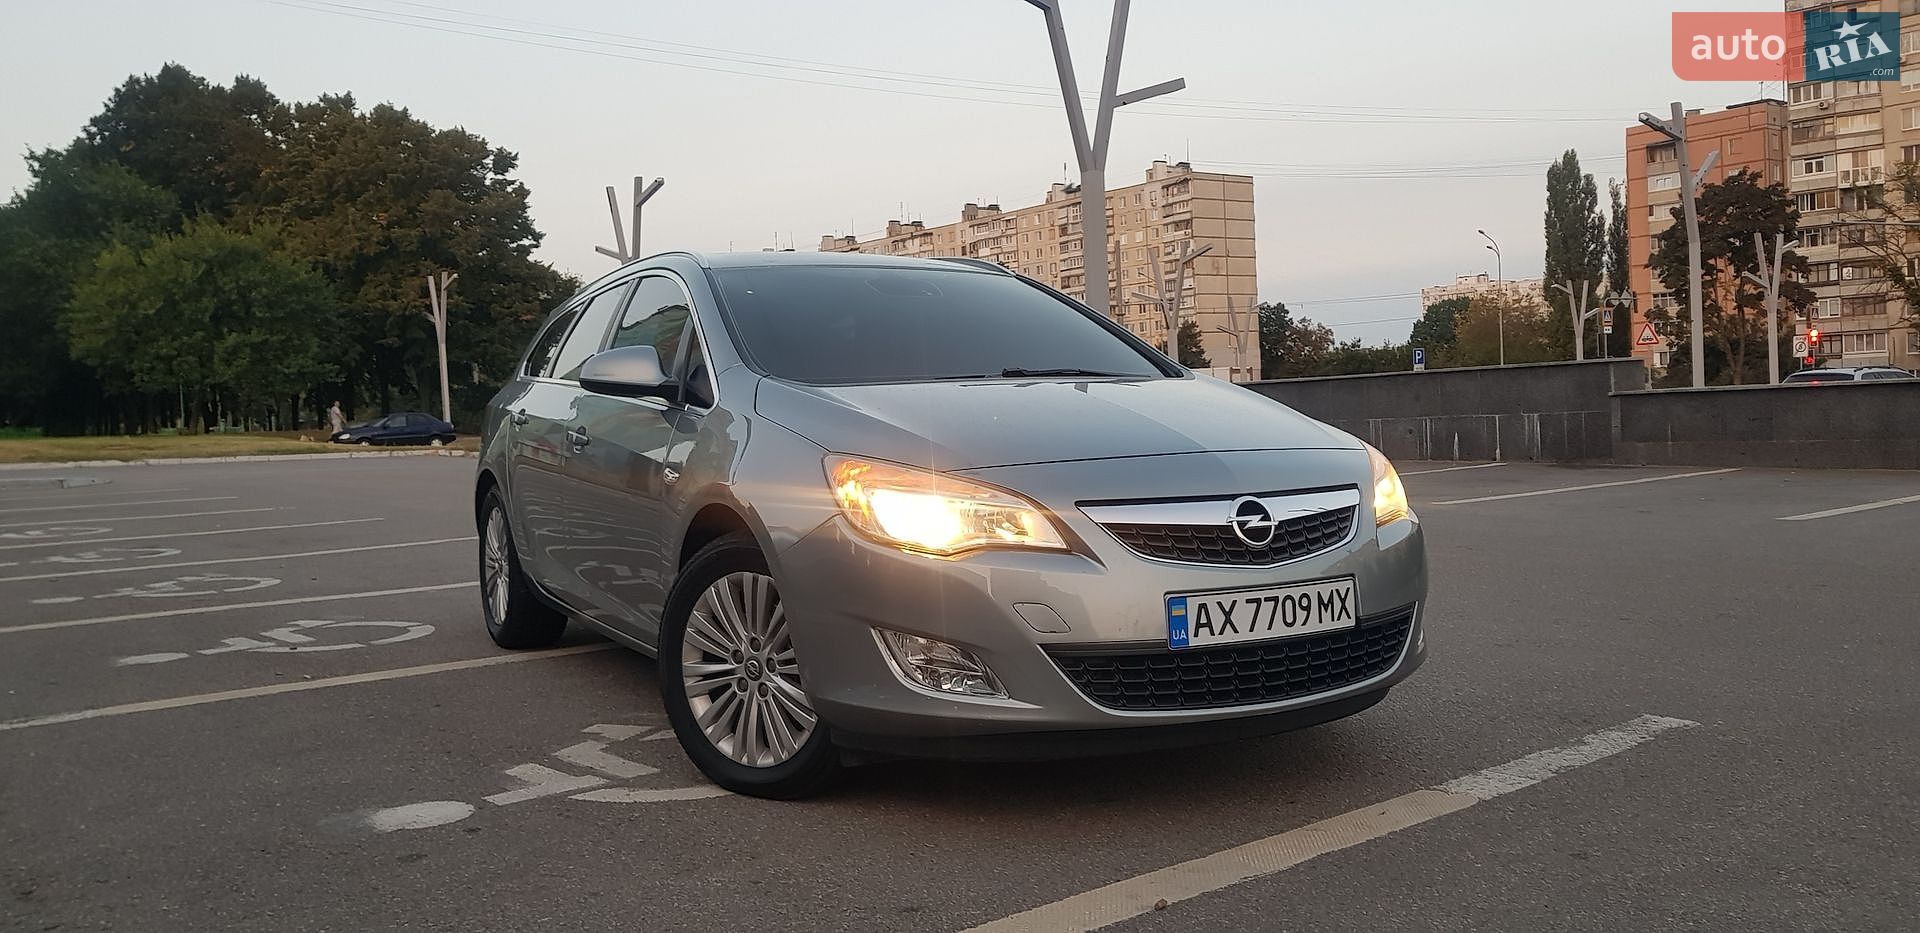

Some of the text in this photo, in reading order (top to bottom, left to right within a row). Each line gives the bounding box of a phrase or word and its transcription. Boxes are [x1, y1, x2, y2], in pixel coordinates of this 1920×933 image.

[1415, 350, 1423, 364] P
[1193, 587, 1352, 638] AX 7709 MX
[1172, 629, 1188, 641] UA
